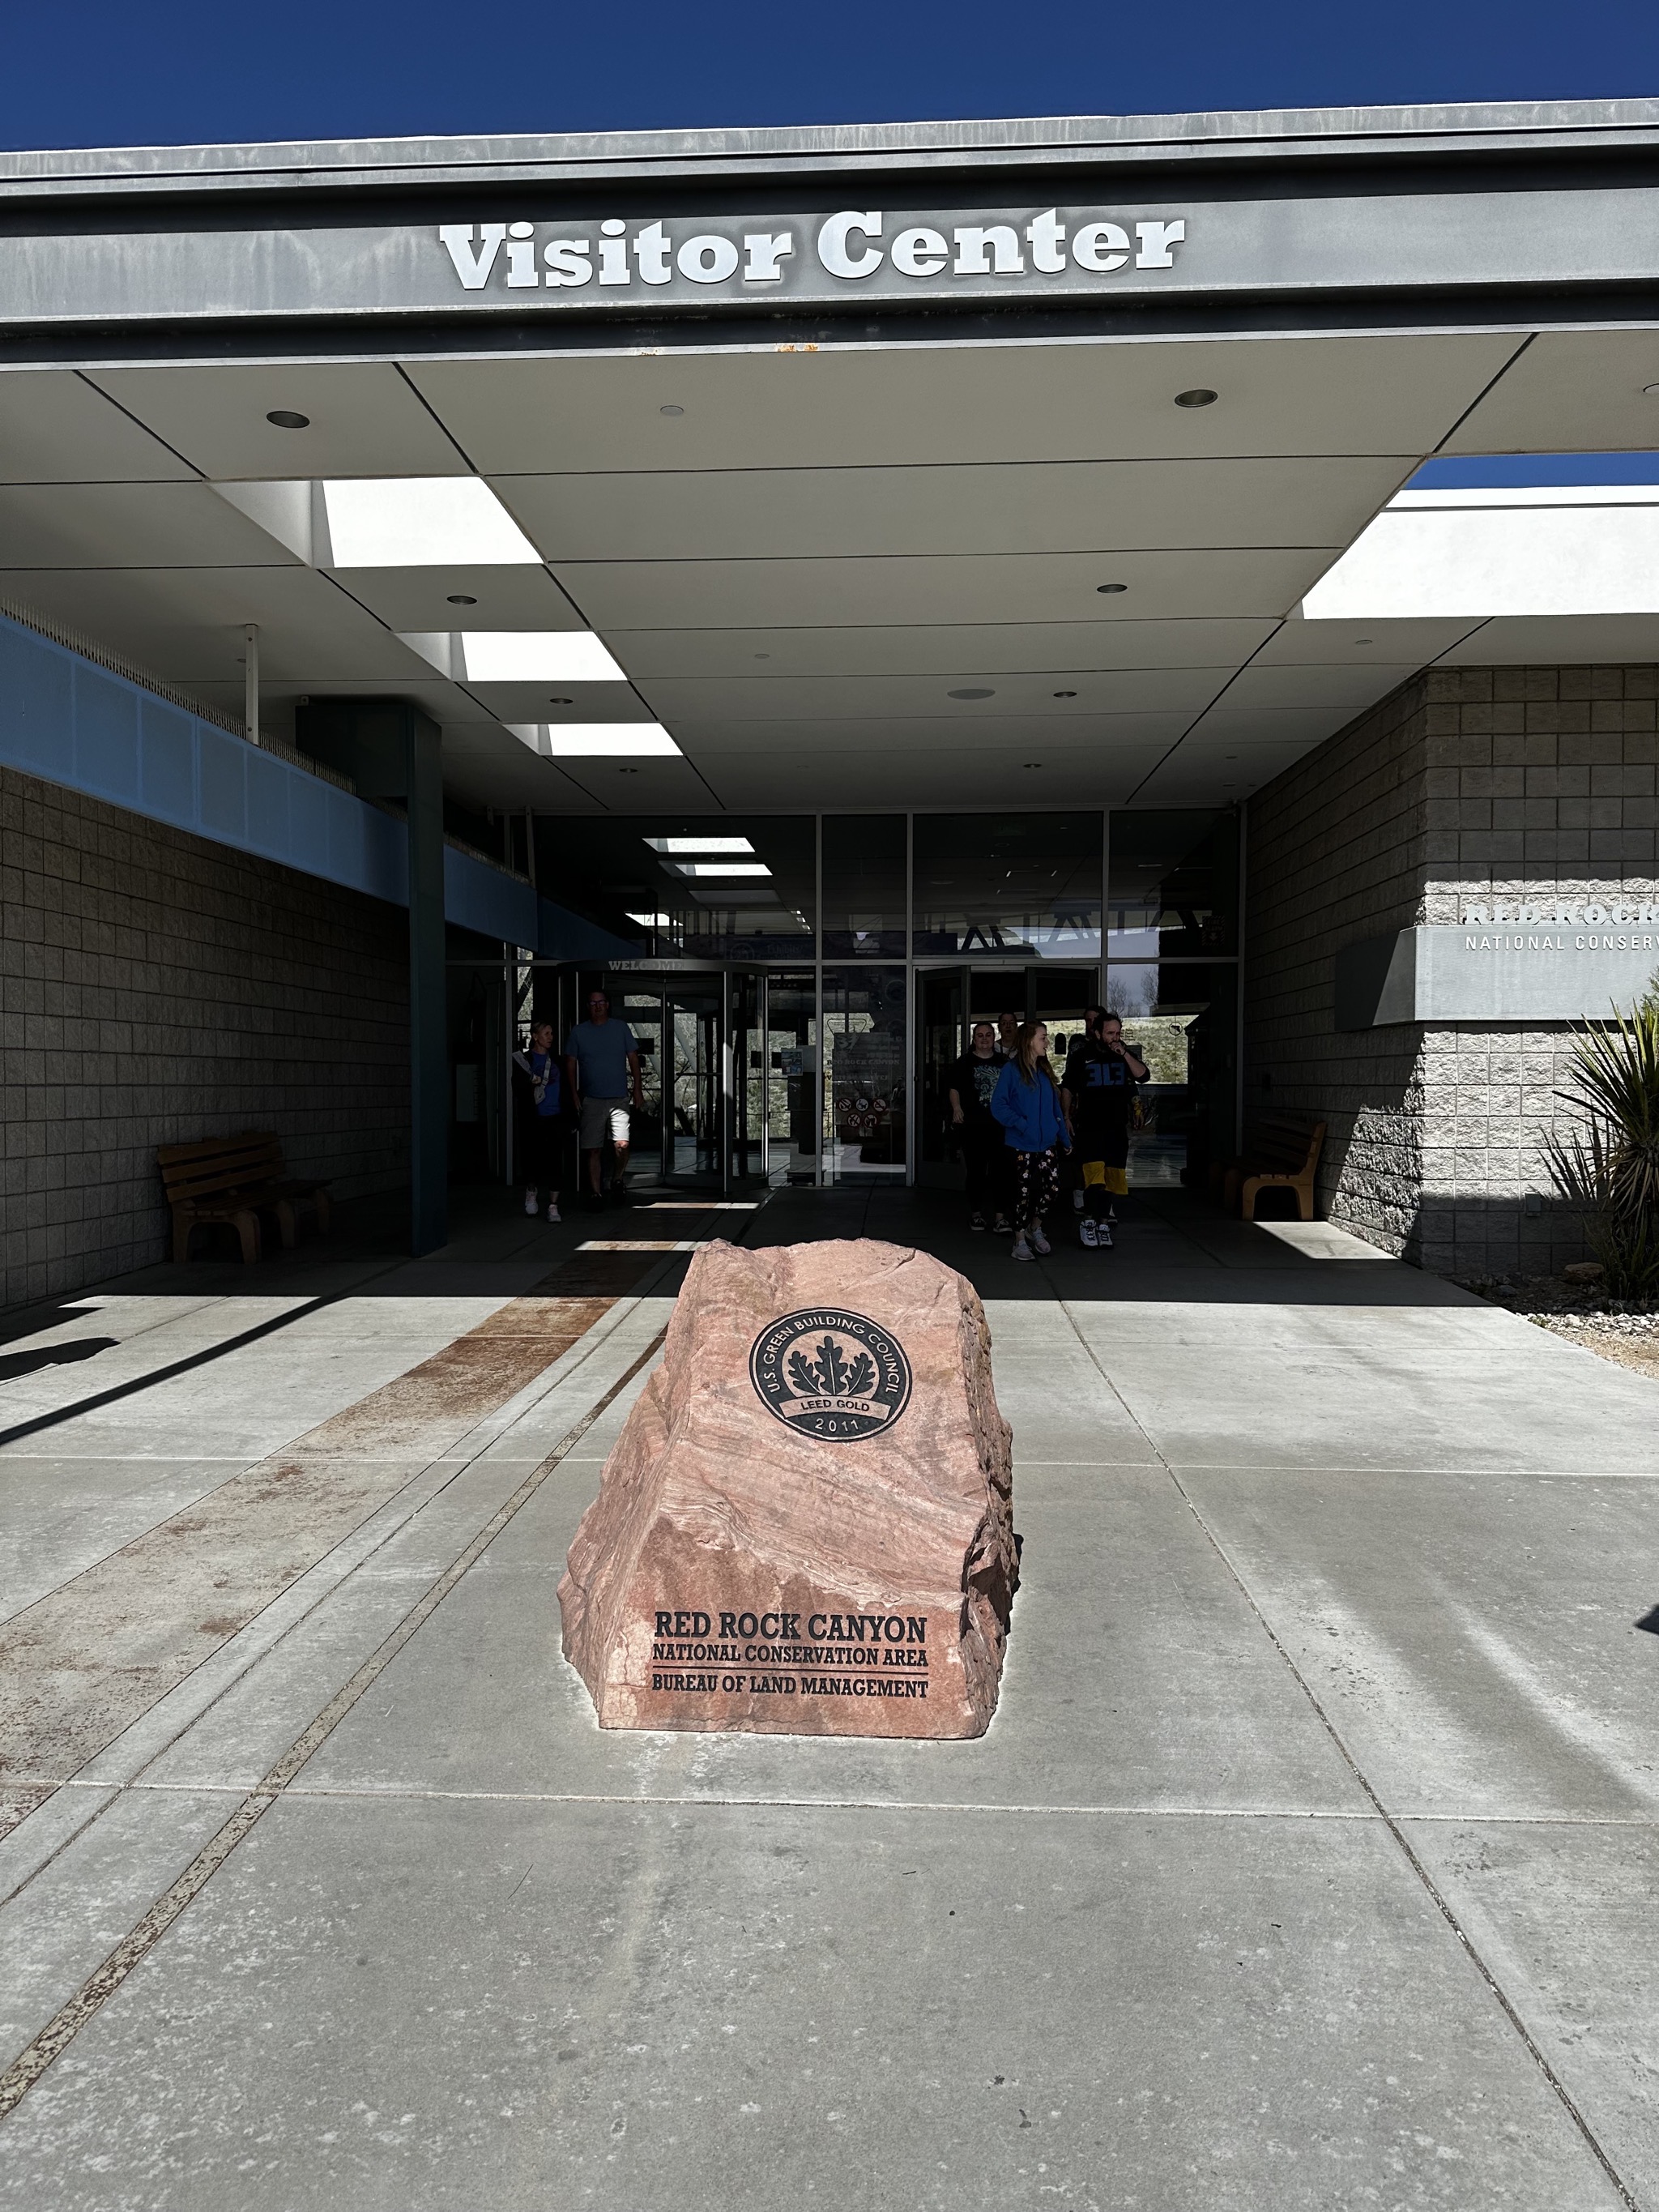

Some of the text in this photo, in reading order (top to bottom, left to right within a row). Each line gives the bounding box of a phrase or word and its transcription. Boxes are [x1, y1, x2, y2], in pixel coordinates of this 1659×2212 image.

[440, 208, 1185, 289] Visitor Center
[1464, 903, 1659, 925] RED ROCK
[1465, 936, 1565, 950] NATIONAL
[608, 960, 683, 971] WELCOME
[763, 1316, 901, 1394] U.S. GREEN BUILDING COUNCIL
[800, 1399, 870, 1411] LEED GOLD
[815, 1418, 859, 1433] 2011
[655, 1612, 928, 1643] RED ROCK CANYON
[652, 1644, 928, 1667] NATIONAL CONSERVATION AREA
[652, 1674, 928, 1698] BUREAU OF LAND MANAGEMENT
